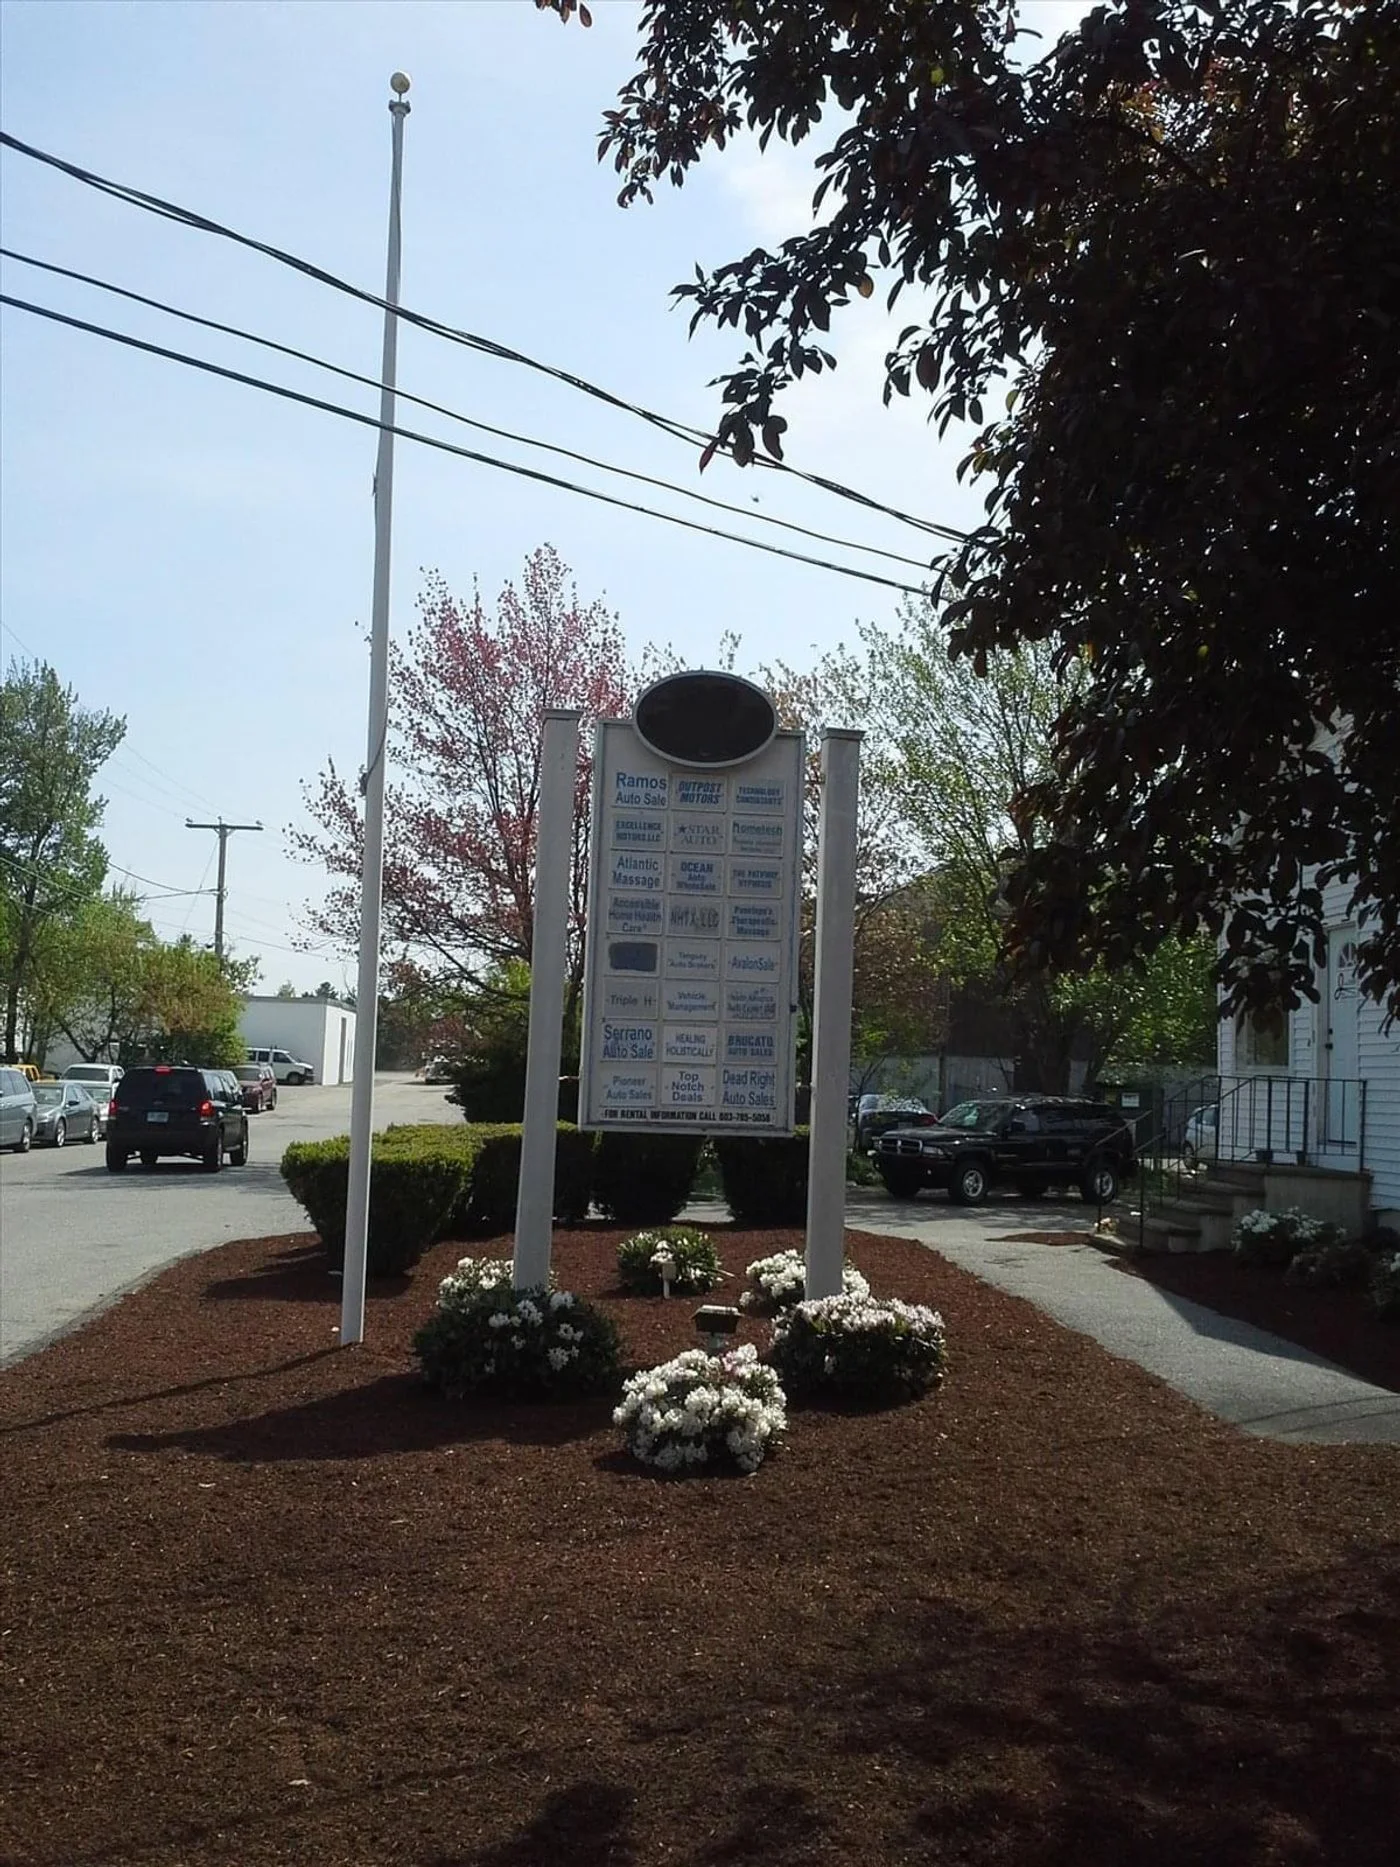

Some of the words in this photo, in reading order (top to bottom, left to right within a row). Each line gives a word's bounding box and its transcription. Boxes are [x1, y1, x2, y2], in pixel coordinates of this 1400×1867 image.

[616, 772, 667, 790] Ramos
[679, 781, 722, 793] OUTPOST
[616, 791, 641, 804] Auto
[644, 793, 667, 806] Sale
[679, 793, 721, 804] MOTORS
[688, 824, 719, 834] STAR
[680, 835, 717, 845] AUTO
[617, 856, 659, 871] Atlantic
[681, 862, 713, 873] OCEAN
[612, 871, 660, 888] Massage
[610, 994, 638, 1006] Triple
[644, 996, 651, 1006] H
[604, 1024, 652, 1041] Serrano
[676, 1033, 705, 1044] HEALING
[603, 1044, 628, 1058] Auto
[630, 1044, 653, 1059] Sale
[679, 1071, 699, 1083] Top
[722, 1068, 748, 1085] Dead
[750, 1070, 774, 1090] Right
[671, 1082, 704, 1092] Notch
[606, 1089, 627, 1099] Auto
[629, 1090, 652, 1100] Sales
[672, 1091, 703, 1102] Deals
[722, 1091, 746, 1105] Auto
[748, 1091, 774, 1106] Sales
[604, 1109, 618, 1118] FOR
[620, 1109, 647, 1119] RENTAL
[650, 1110, 697, 1120] INFORMATION
[699, 1111, 716, 1120] CALL
